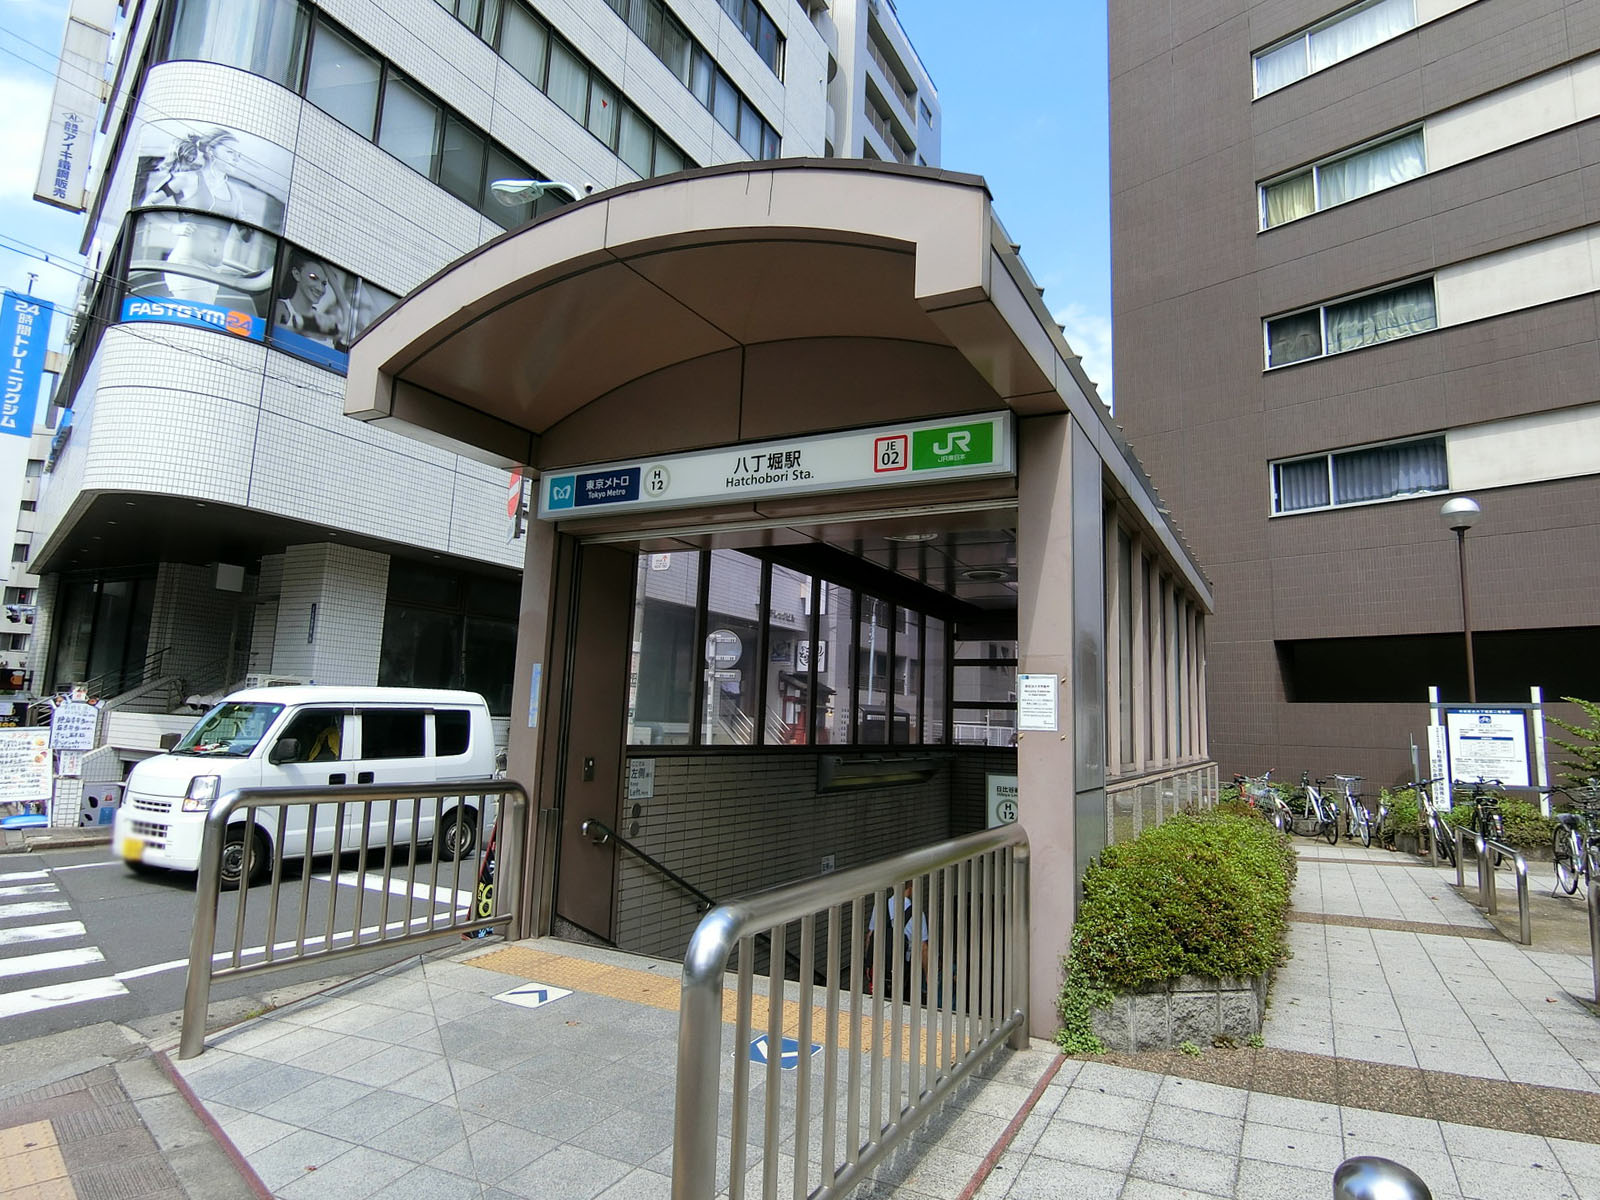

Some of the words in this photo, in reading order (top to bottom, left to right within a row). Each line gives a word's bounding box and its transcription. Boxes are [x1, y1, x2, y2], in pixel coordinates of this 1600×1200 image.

[885, 441, 896, 451] JE
[933, 431, 971, 455] JR
[734, 450, 801, 474] 八丁堀駅
[882, 451, 899, 465] 02
[653, 470, 661, 479] H
[726, 470, 788, 488] Hatchobori
[792, 469, 814, 480] Sta.
[585, 476, 629, 491] 東京メトロ
[651, 480, 663, 491] 12
[588, 491, 606, 499] Tokyo
[606, 488, 626, 497] Metro
[1003, 811, 1014, 820] 12
